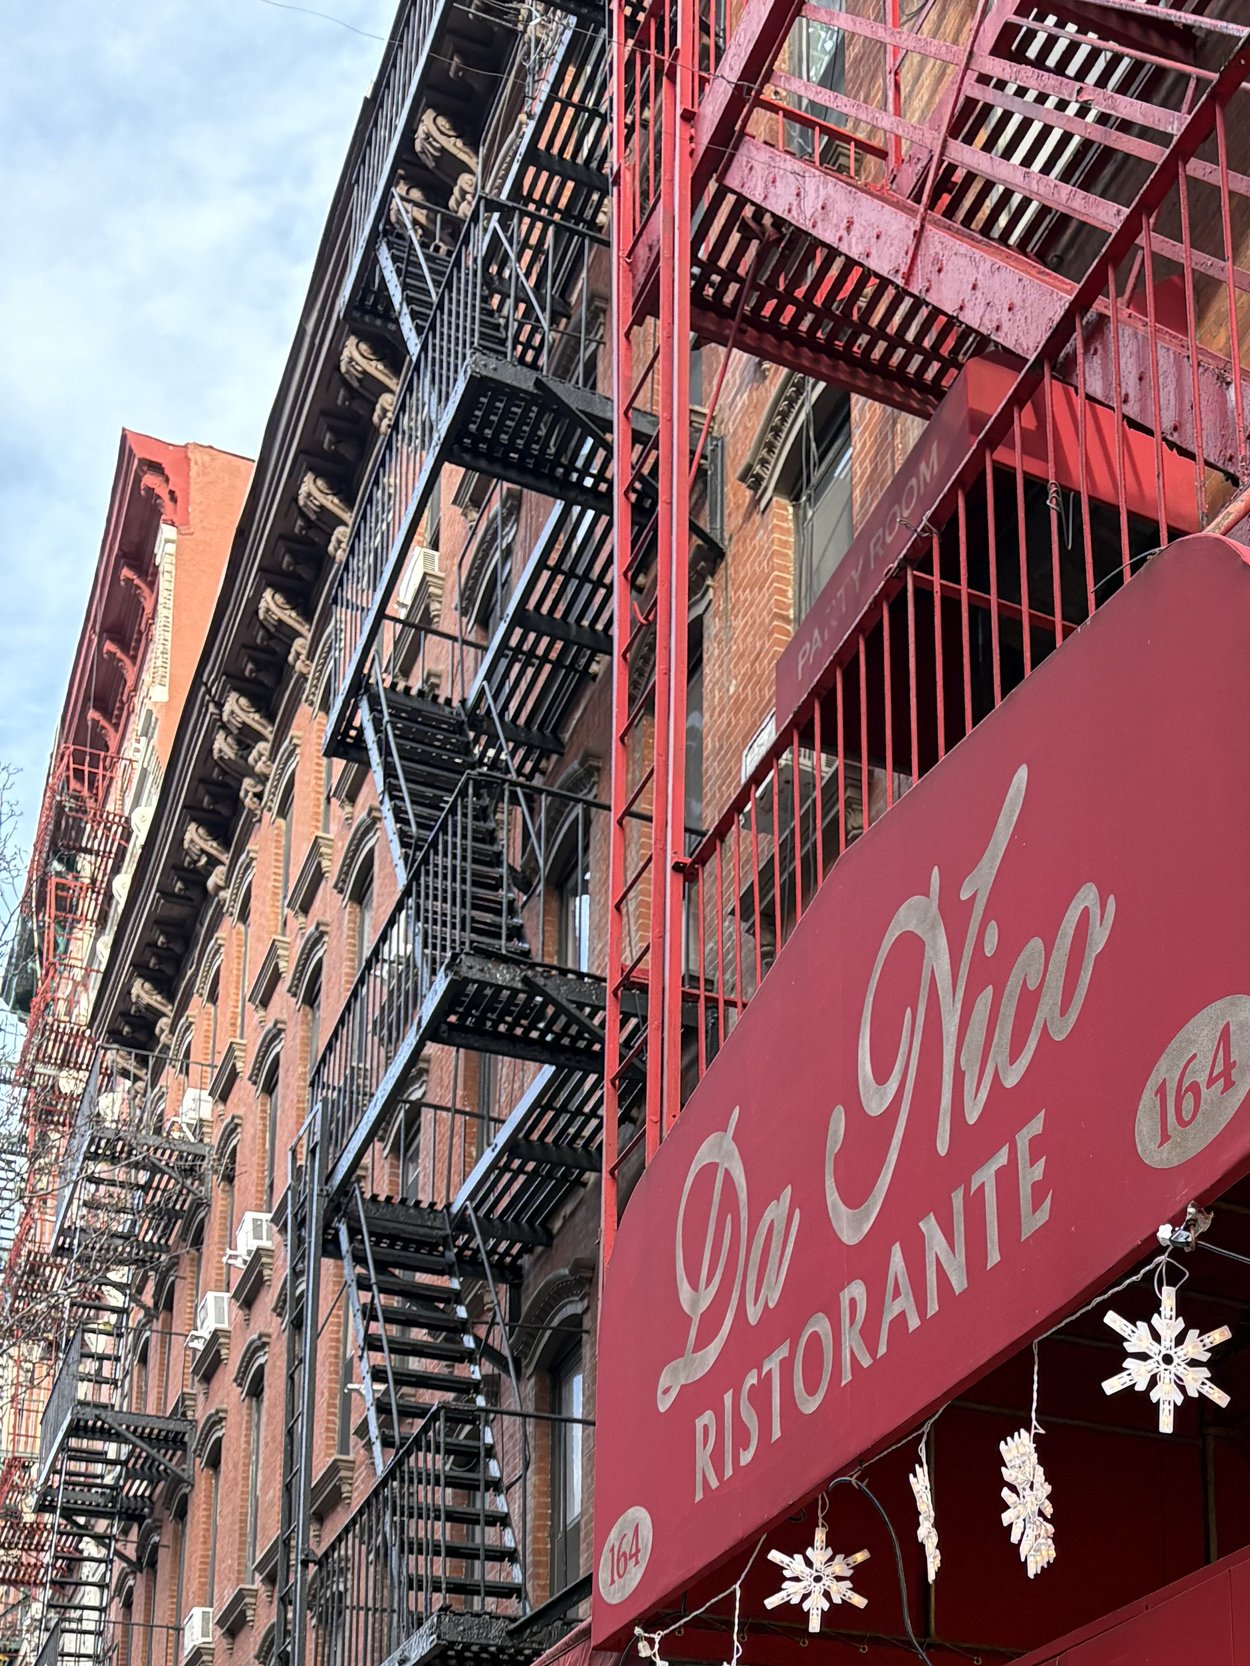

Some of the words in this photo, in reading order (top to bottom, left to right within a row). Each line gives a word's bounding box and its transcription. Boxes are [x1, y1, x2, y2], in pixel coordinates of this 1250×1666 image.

[869, 440, 939, 571] ROOM
[659, 1106, 801, 1413] Da
[826, 764, 1116, 1245] Nico
[1154, 1021, 1237, 1149] 164
[694, 1108, 1053, 1503] RISTORANTE
[609, 1522, 641, 1587] 164
